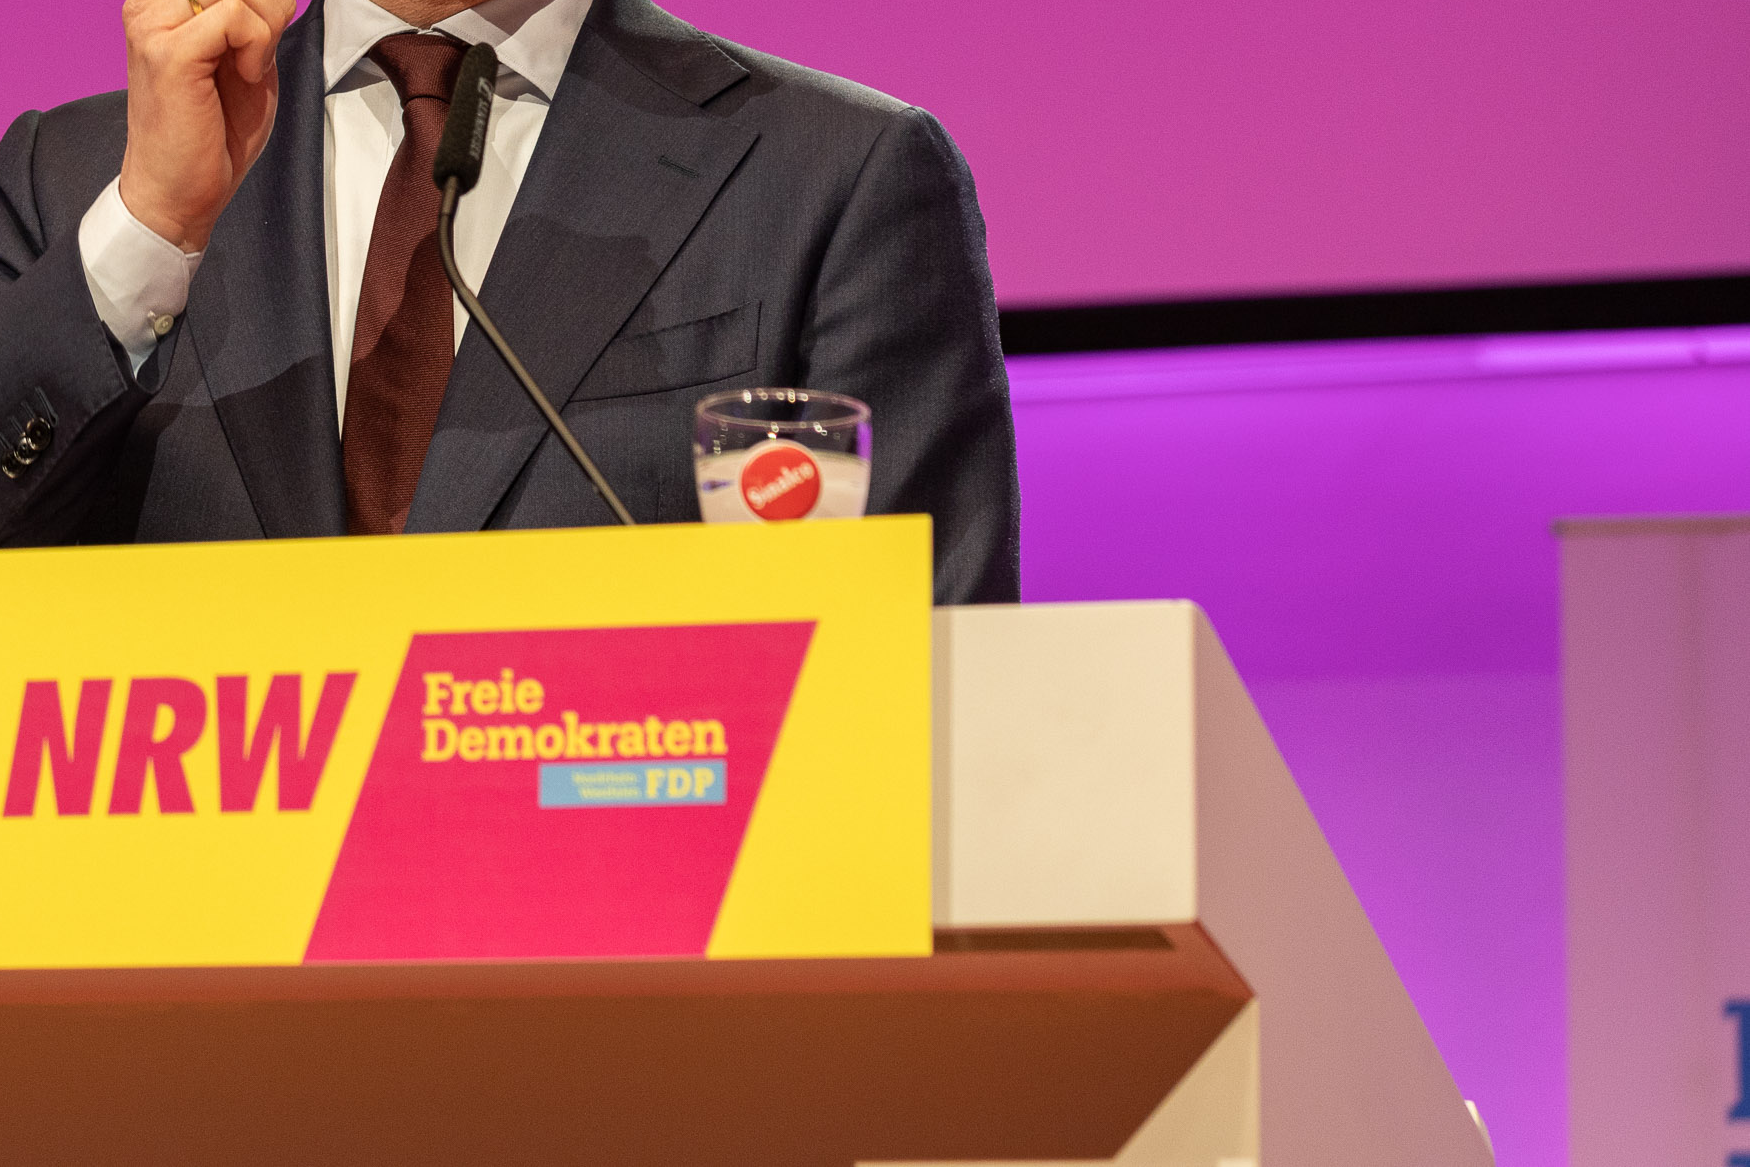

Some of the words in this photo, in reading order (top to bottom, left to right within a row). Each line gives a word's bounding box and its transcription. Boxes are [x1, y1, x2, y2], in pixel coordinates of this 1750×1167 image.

[421, 668, 545, 717] Freie
[1, 671, 359, 819] NRW
[420, 710, 729, 763] Demokraten
[645, 766, 716, 800] FDP
